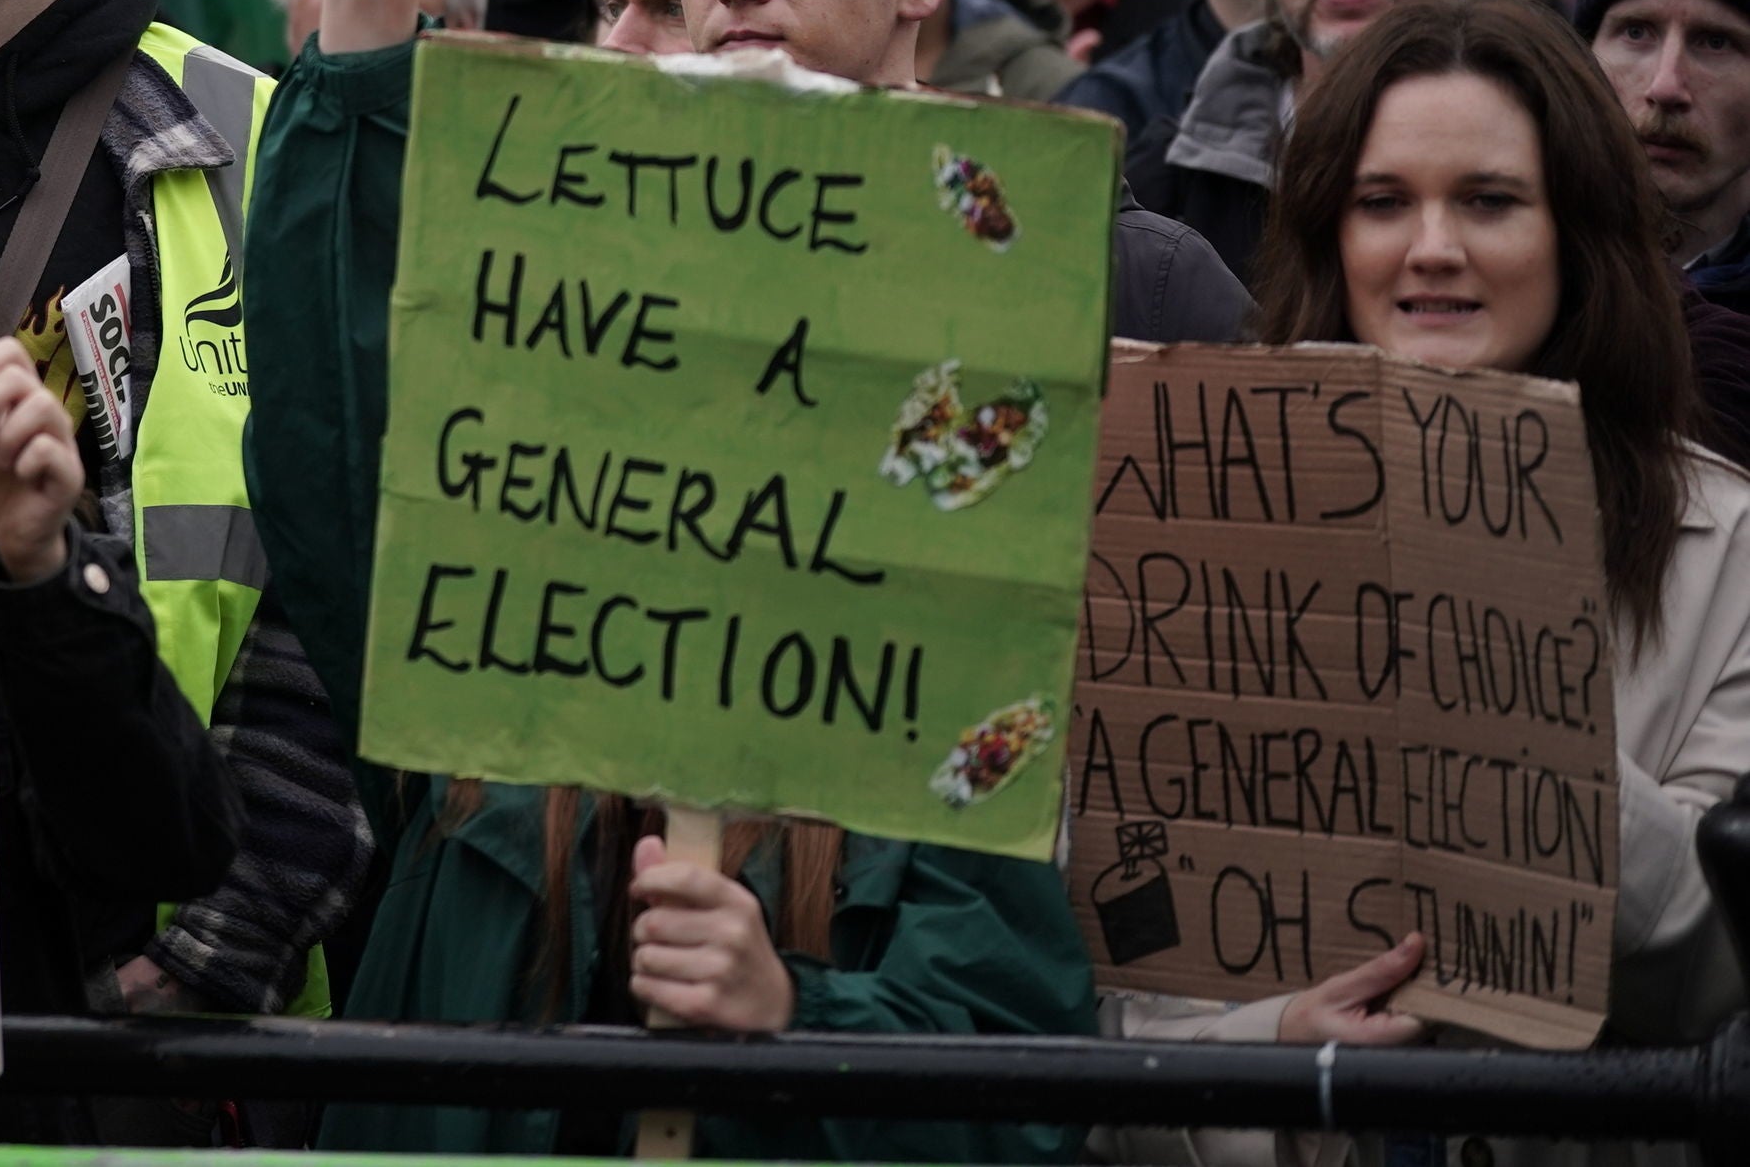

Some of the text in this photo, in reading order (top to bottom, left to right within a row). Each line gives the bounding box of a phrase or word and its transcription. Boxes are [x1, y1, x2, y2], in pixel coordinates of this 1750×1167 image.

[476, 96, 868, 252] LETTUCE
[179, 332, 249, 375] Unit
[471, 250, 819, 407] HAVE A
[437, 407, 886, 585] GENERAL
[1096, 381, 1564, 545] WHAT'S YOUR
[408, 563, 924, 742] ELECTION!
[1085, 550, 1329, 701] DRINK
[1356, 581, 1416, 701] OF
[1140, 713, 1394, 837] GENERAL
